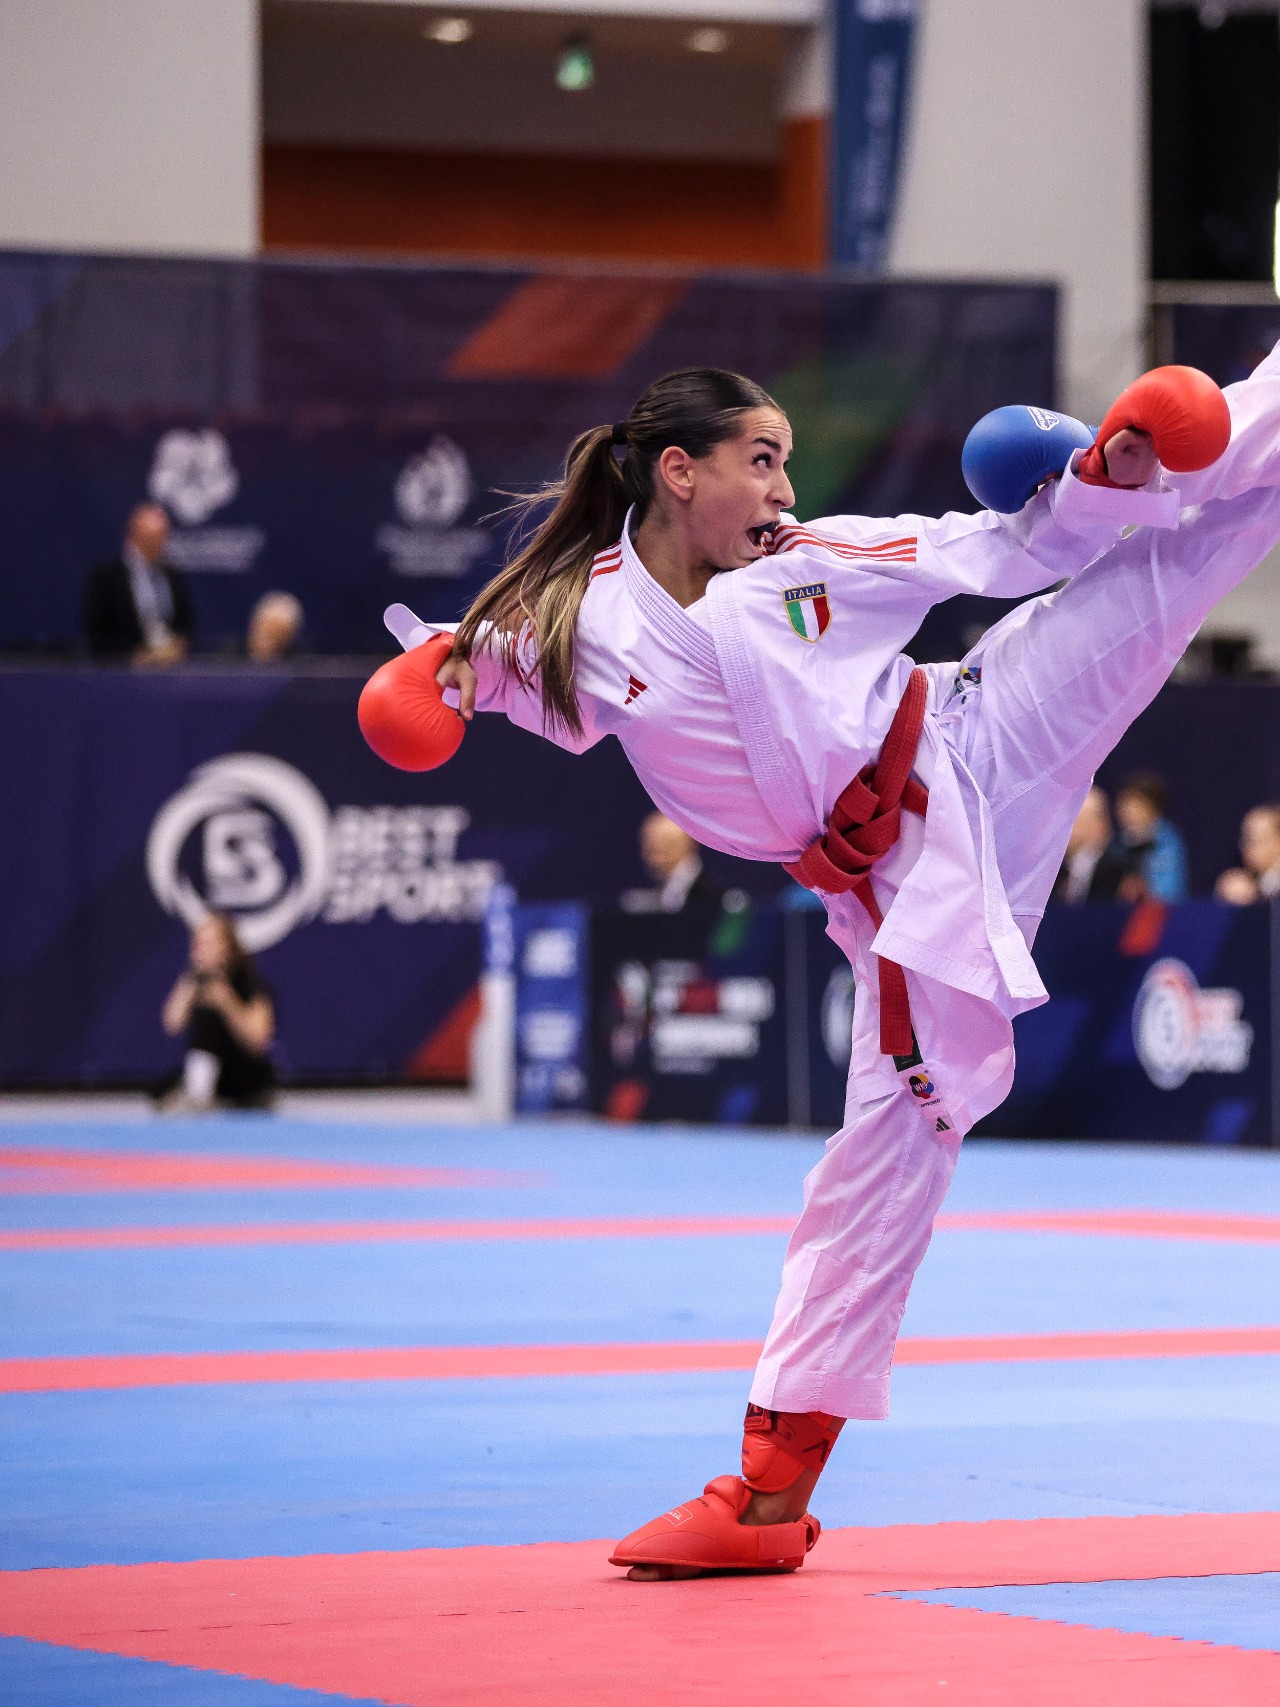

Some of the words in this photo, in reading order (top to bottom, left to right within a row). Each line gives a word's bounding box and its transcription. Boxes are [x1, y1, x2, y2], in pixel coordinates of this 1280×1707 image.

[787, 585, 823, 600] ITALIA
[333, 804, 472, 864] BEST
[322, 860, 504, 924] SPORT
